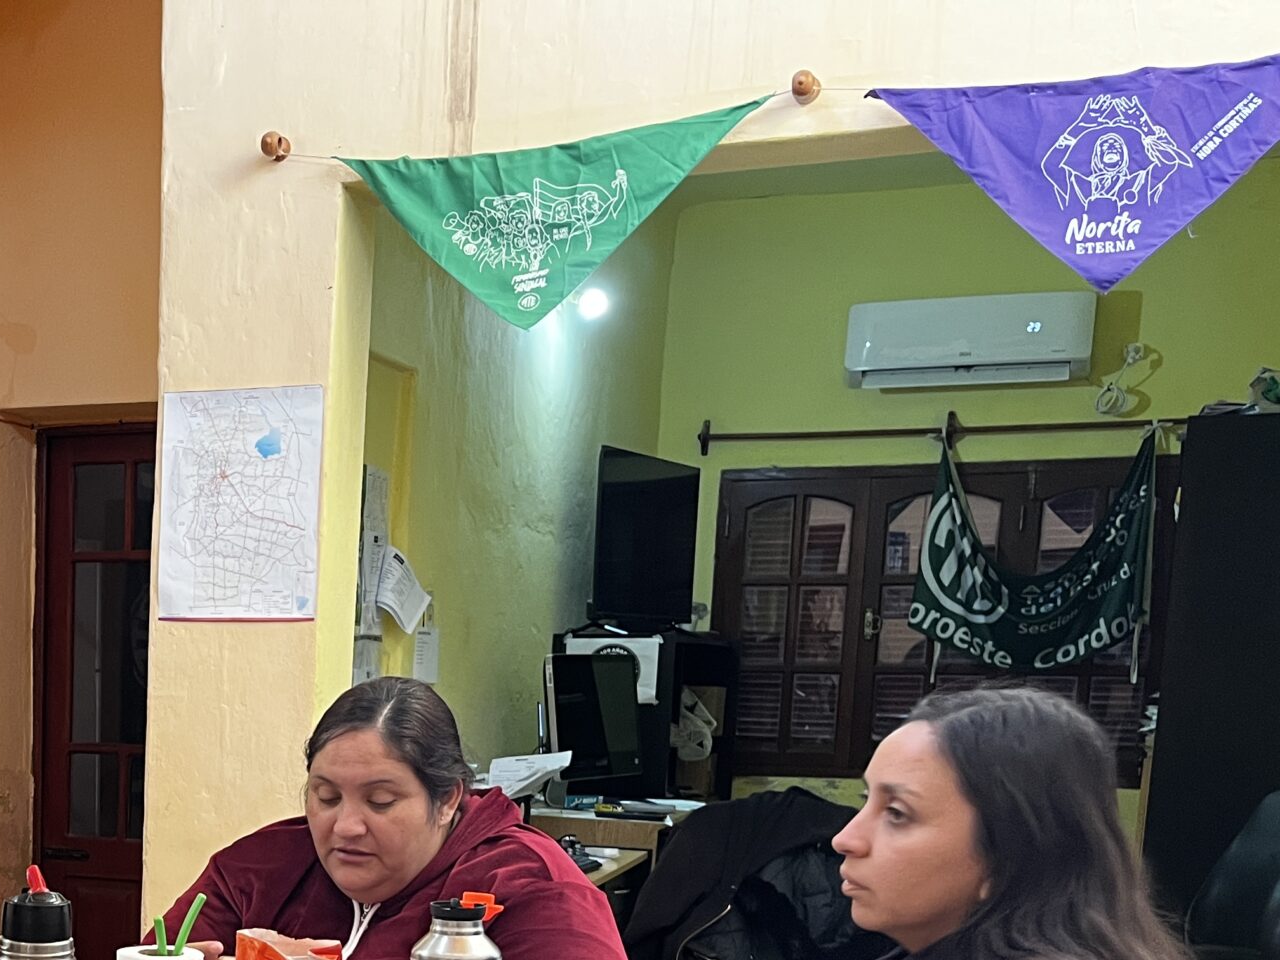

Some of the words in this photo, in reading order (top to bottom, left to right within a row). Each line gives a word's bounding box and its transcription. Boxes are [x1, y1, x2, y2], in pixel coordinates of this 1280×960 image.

[1196, 136, 1223, 160] NORA
[1065, 211, 1141, 244] Norita
[1076, 239, 1136, 254] ETERNA
[908, 602, 1013, 669] oroeste
